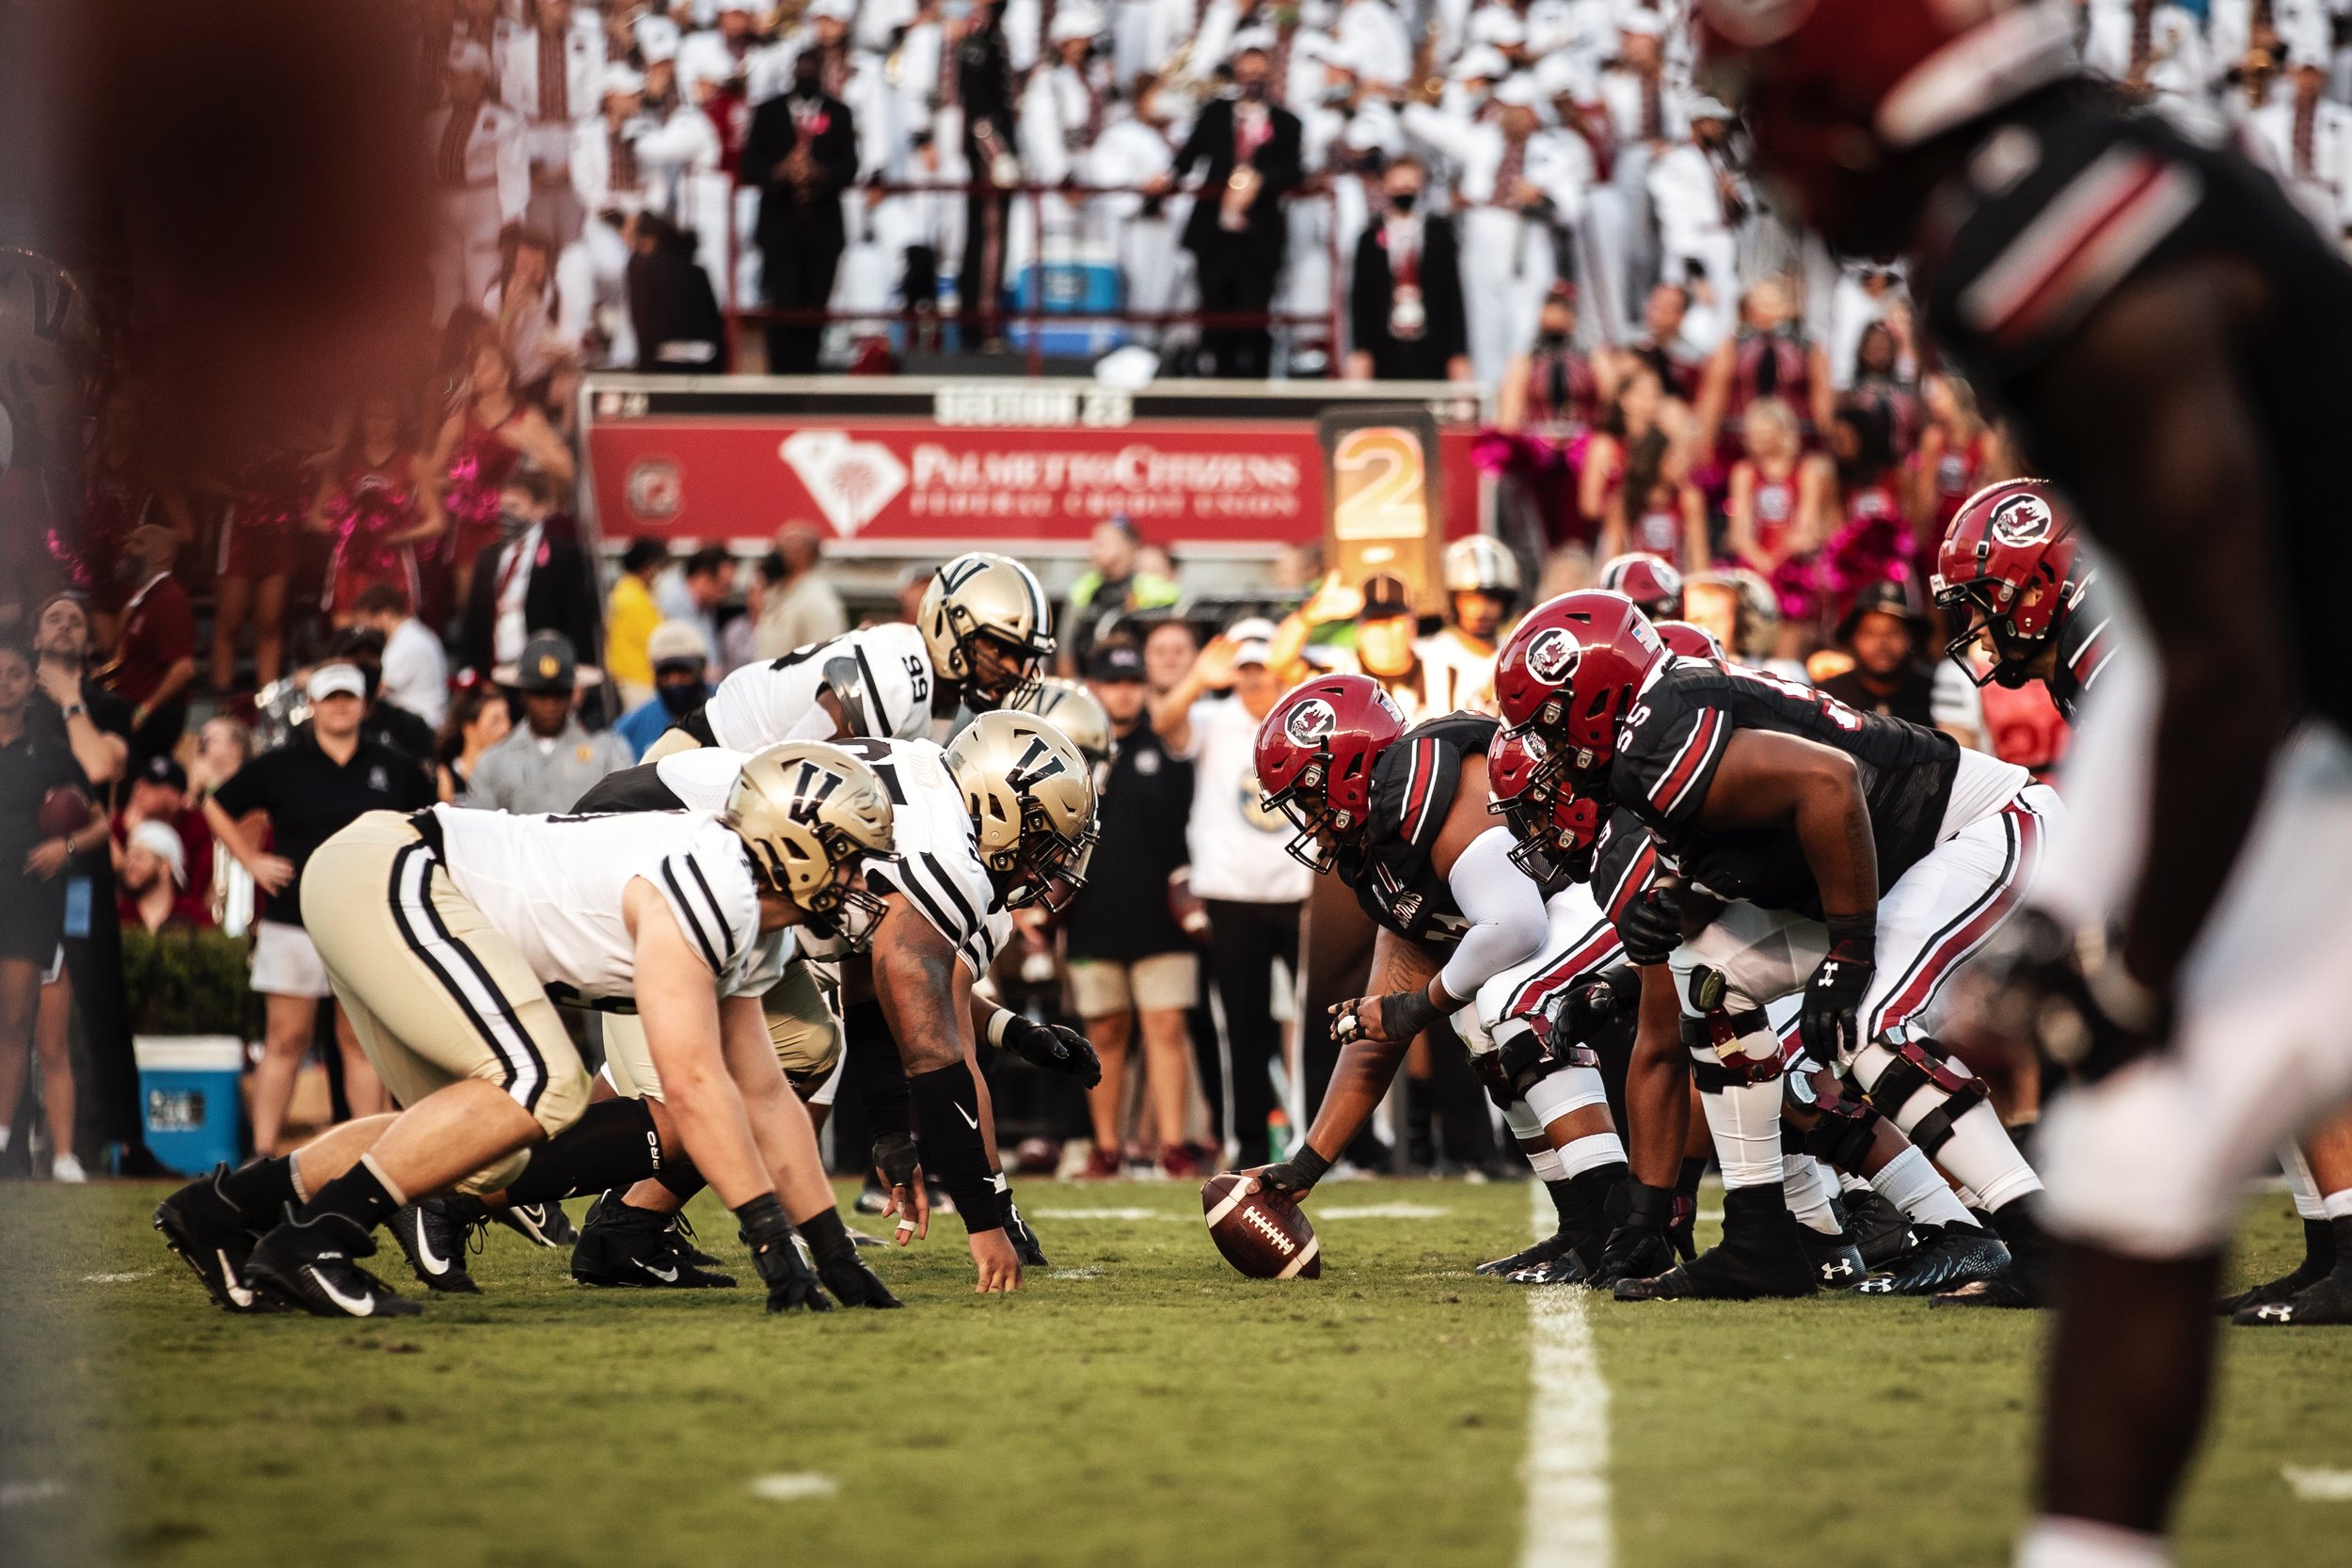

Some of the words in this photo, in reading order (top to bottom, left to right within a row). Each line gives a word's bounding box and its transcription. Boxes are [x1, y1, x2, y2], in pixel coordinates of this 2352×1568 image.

[934, 386, 1077, 427] SECTION
[910, 491, 1053, 518] FEDERAL
[1063, 491, 1185, 519] CREDIT
[1194, 491, 1300, 519] UNION
[1333, 427, 1427, 541] 2
[901, 655, 929, 704] 99
[1004, 736, 1067, 795] V
[787, 760, 845, 828] V
[1392, 890, 1423, 929] COCKS
[646, 1131, 660, 1170] PRO
